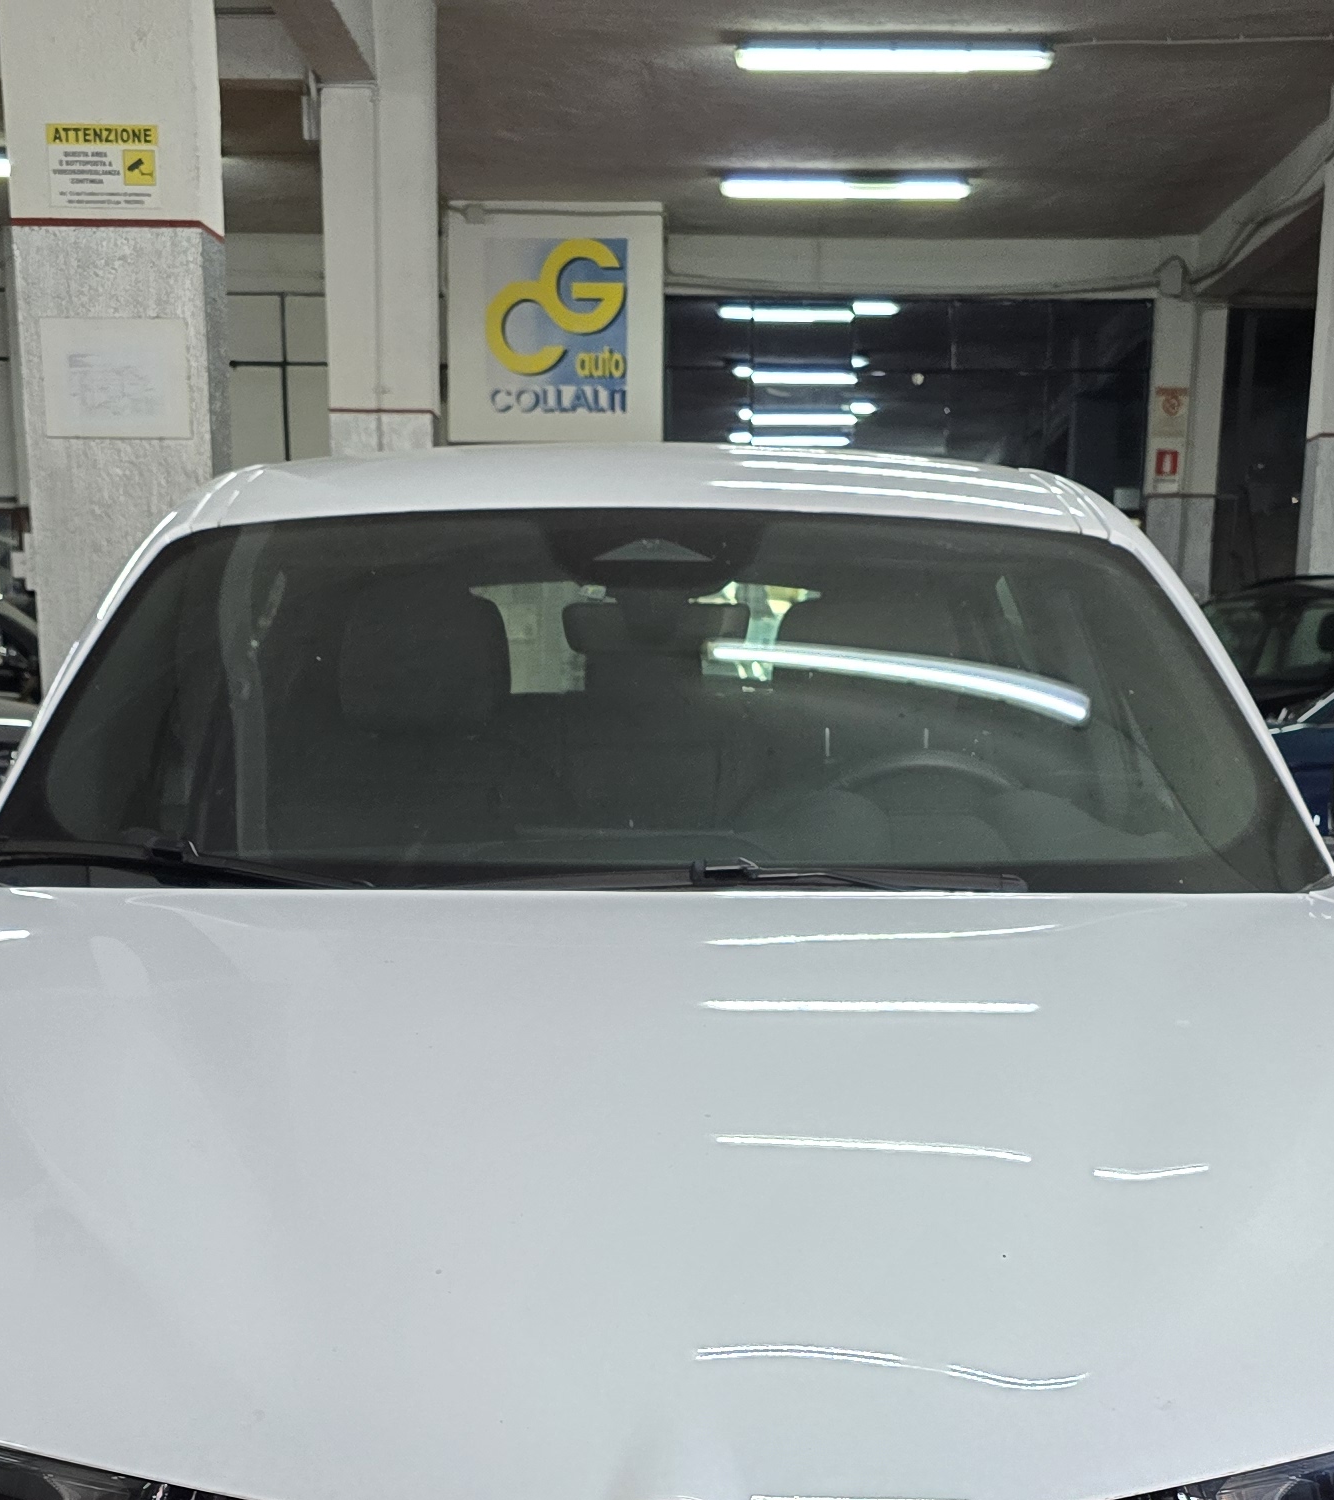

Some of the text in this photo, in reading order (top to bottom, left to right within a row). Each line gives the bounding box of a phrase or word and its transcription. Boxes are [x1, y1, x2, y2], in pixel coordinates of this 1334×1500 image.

[52, 127, 152, 144] ATTENZIONE
[575, 345, 627, 378] auto
[490, 385, 628, 414] COLLALTI
